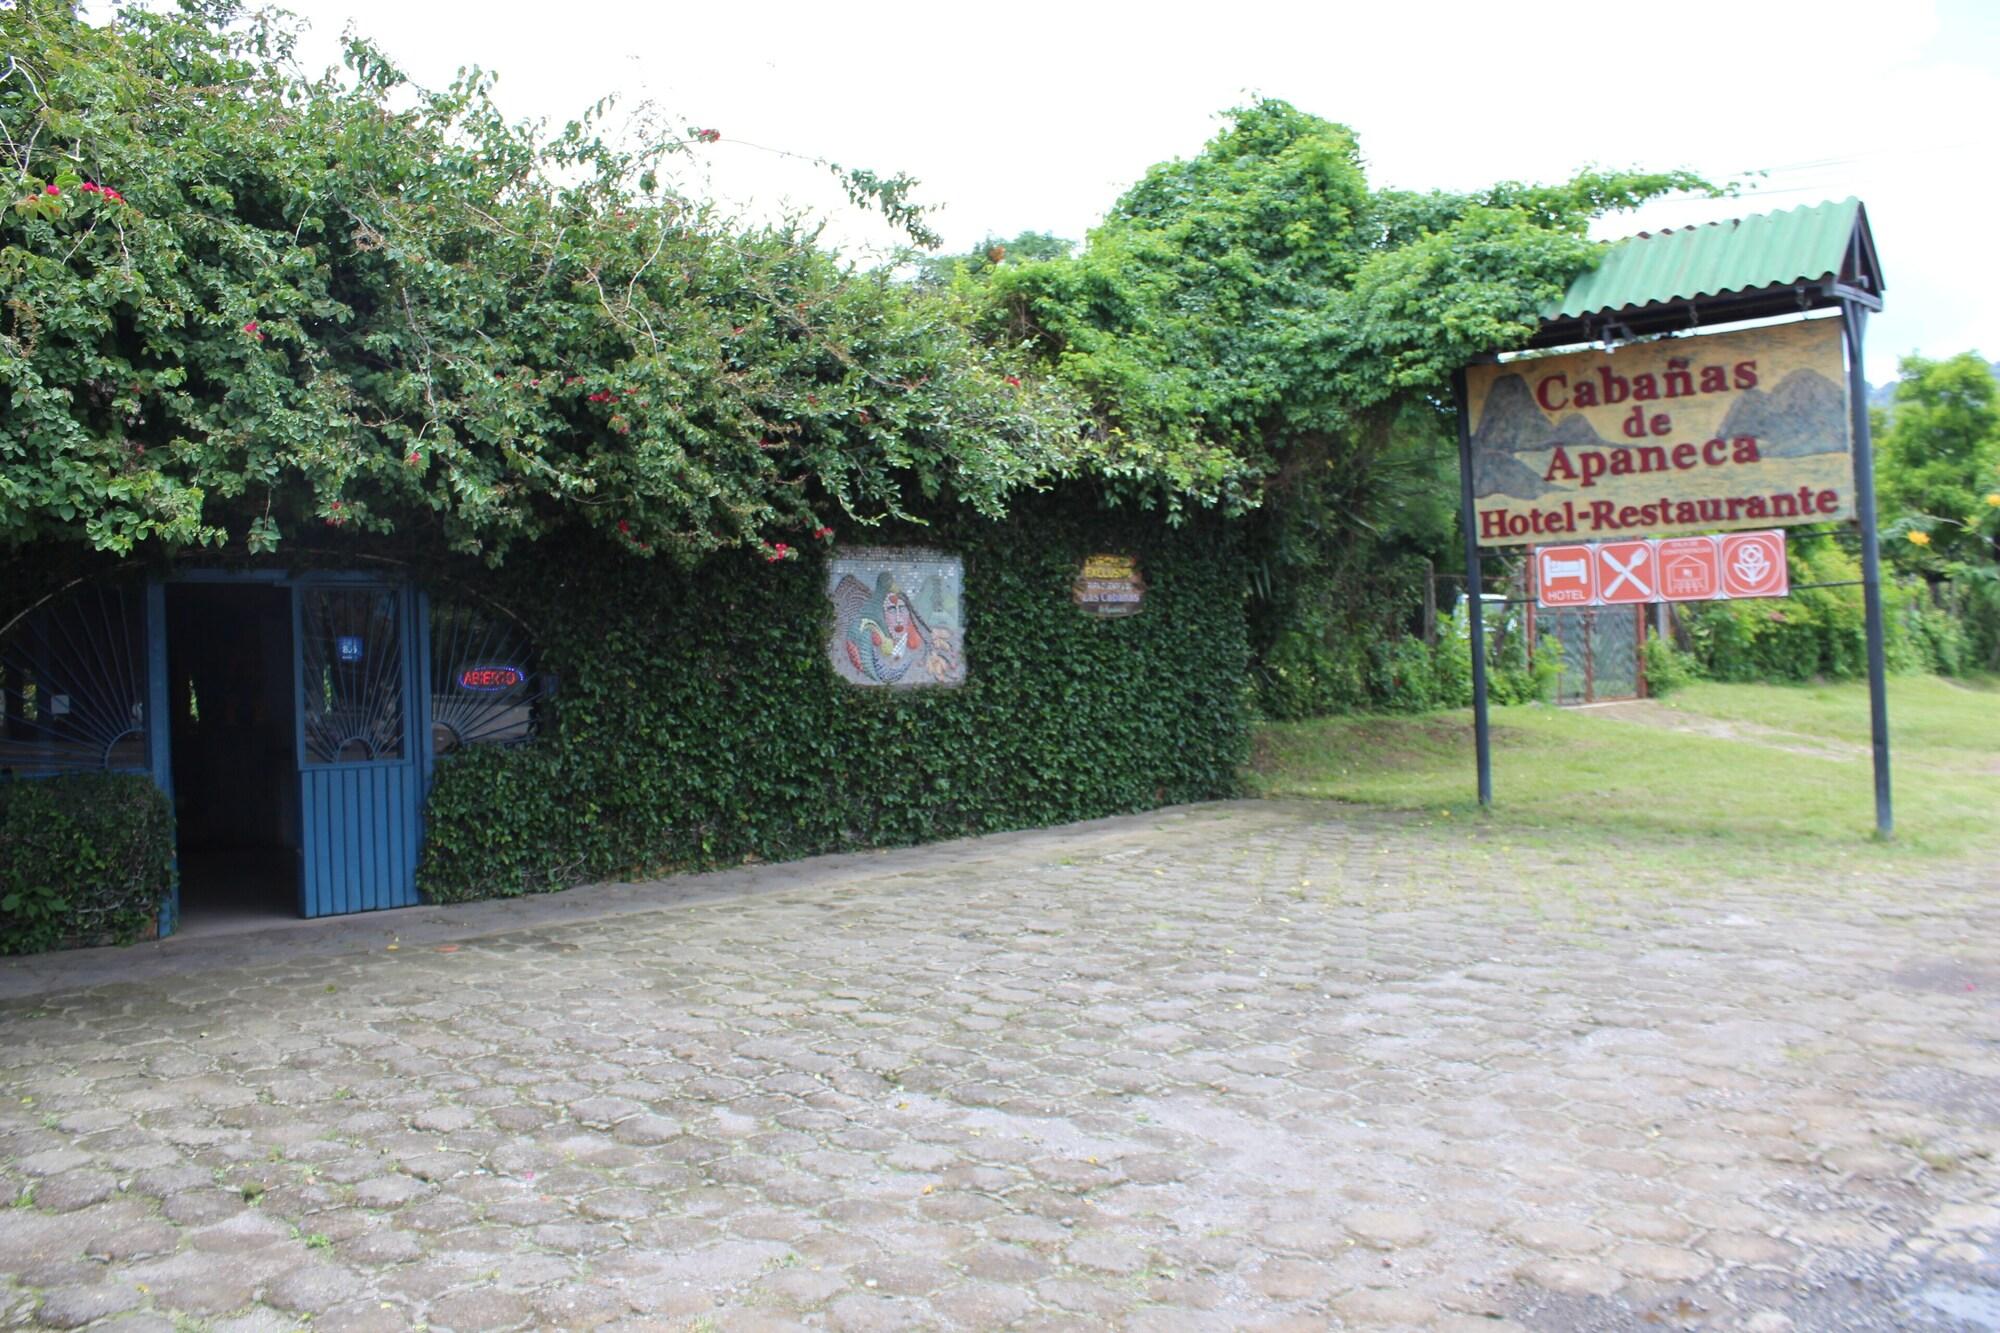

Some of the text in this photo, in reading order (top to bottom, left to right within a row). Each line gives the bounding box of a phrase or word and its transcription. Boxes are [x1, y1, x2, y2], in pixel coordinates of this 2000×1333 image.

[1536, 358, 1759, 411] Cabañas
[1622, 405, 1672, 438] de
[1544, 434, 1761, 487] Apaneca
[1480, 486, 1839, 539] Hotel-Restaurante
[1547, 590, 1586, 601] HOTEL
